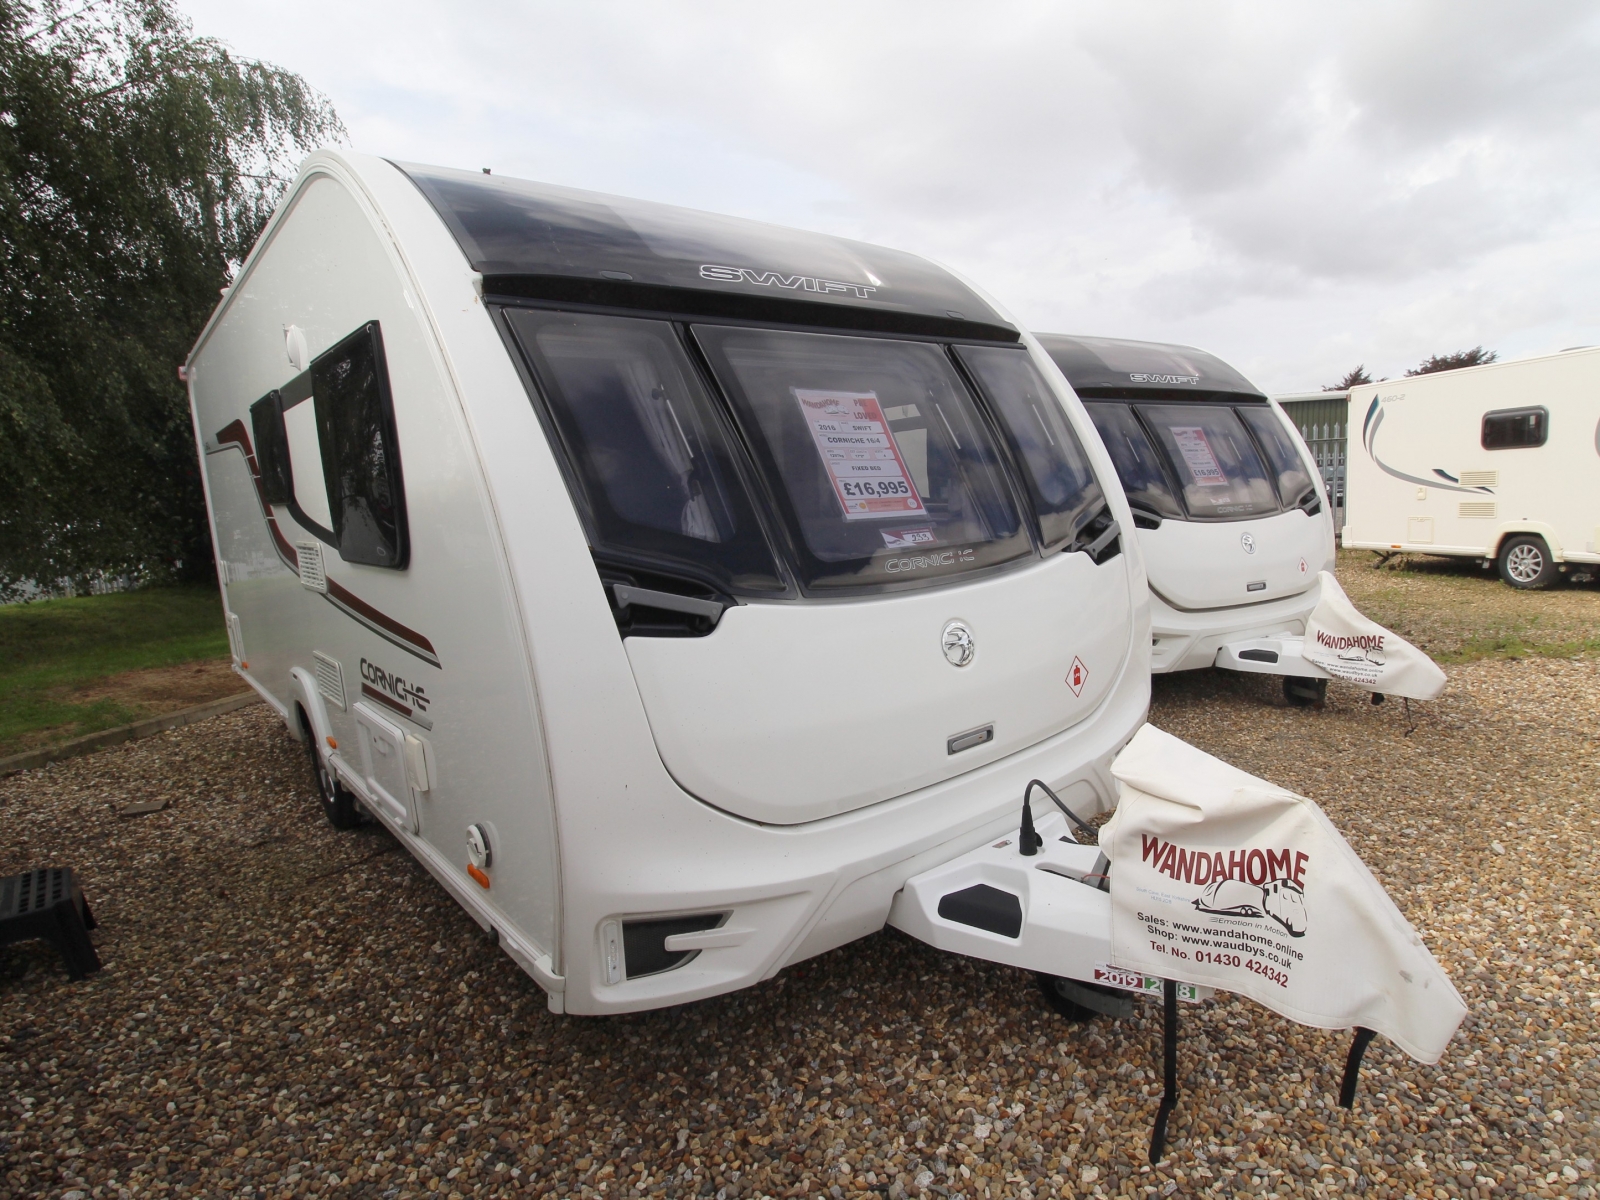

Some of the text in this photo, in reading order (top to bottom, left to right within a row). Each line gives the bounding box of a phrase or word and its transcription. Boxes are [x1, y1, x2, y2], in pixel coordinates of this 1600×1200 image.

[699, 264, 876, 299] SWIFT
[1130, 373, 1199, 385] SWIFT
[801, 398, 840, 409] WANDAHOME
[1381, 393, 1406, 403] 460-2
[853, 411, 877, 420] LOVED
[828, 436, 865, 444] CORNICHE
[843, 481, 909, 498] £16,995
[1317, 629, 1385, 650] WANDAHOME
[360, 657, 430, 712] CORNICHE
[1142, 834, 1310, 889] WANDAHOME
[1137, 912, 1304, 961] Sales: www.wandahome.online
[1218, 917, 1253, 928] Emotion
[1264, 924, 1288, 938] Motion
[1147, 925, 1292, 970] Shop: www.waudbys.co.uk
[1150, 940, 1289, 988] Tel. No. 01430 424342
[1099, 970, 1138, 988] 2019
